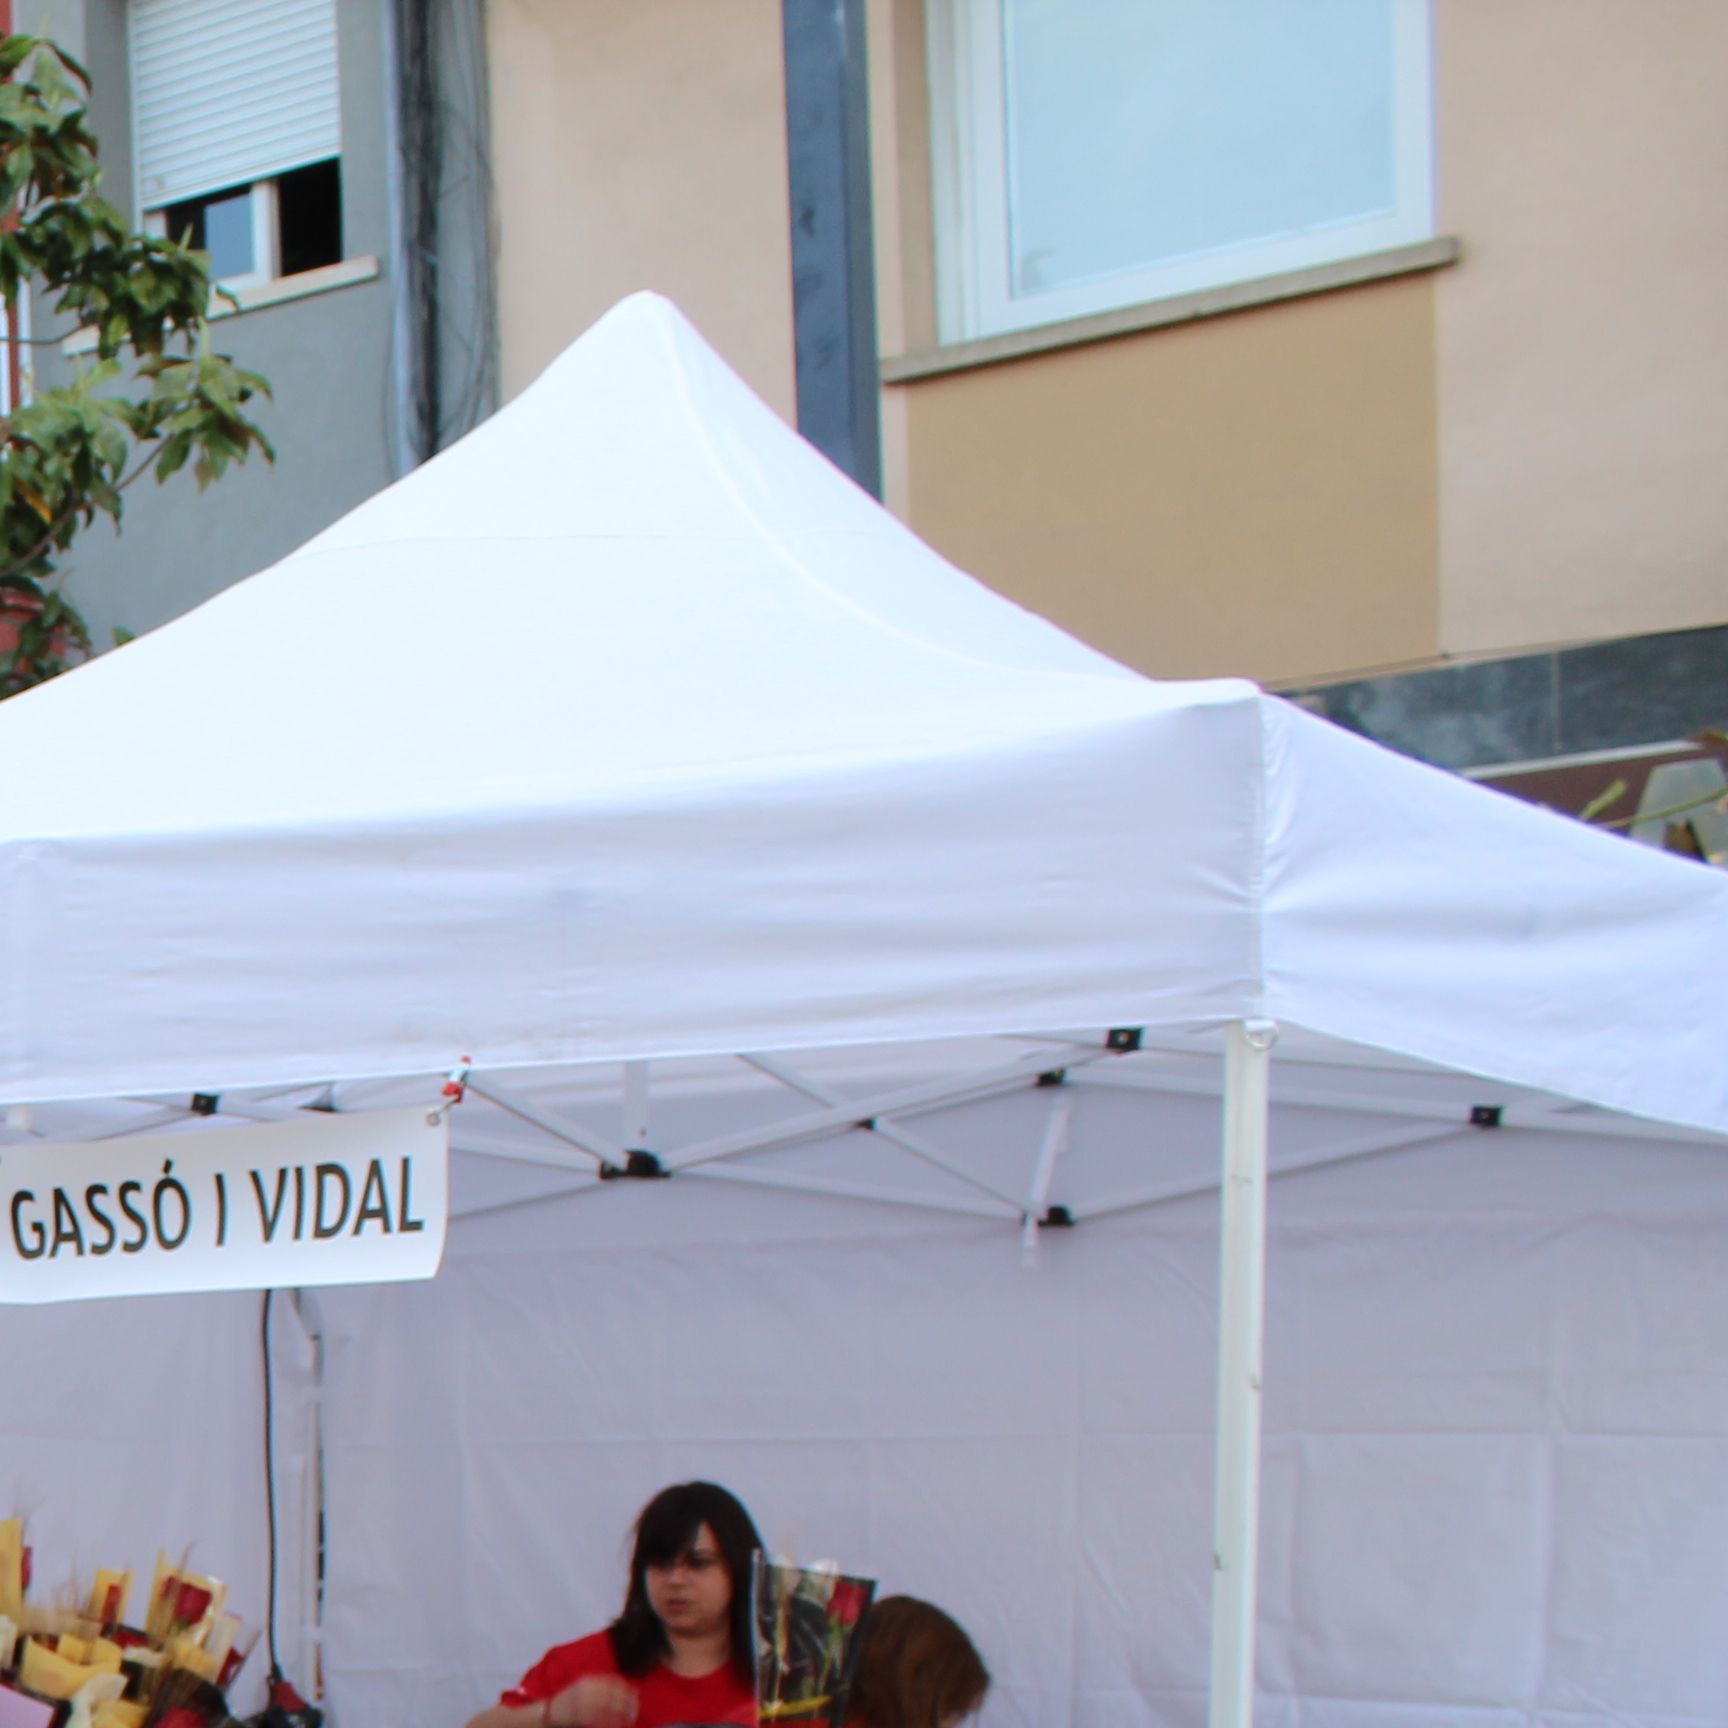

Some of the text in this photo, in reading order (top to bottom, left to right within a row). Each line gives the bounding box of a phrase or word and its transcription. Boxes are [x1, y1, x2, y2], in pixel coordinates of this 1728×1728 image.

[10, 1159, 193, 1261] GASSÓ
[214, 1173, 228, 1246] I
[250, 1156, 425, 1244] VIDAL
